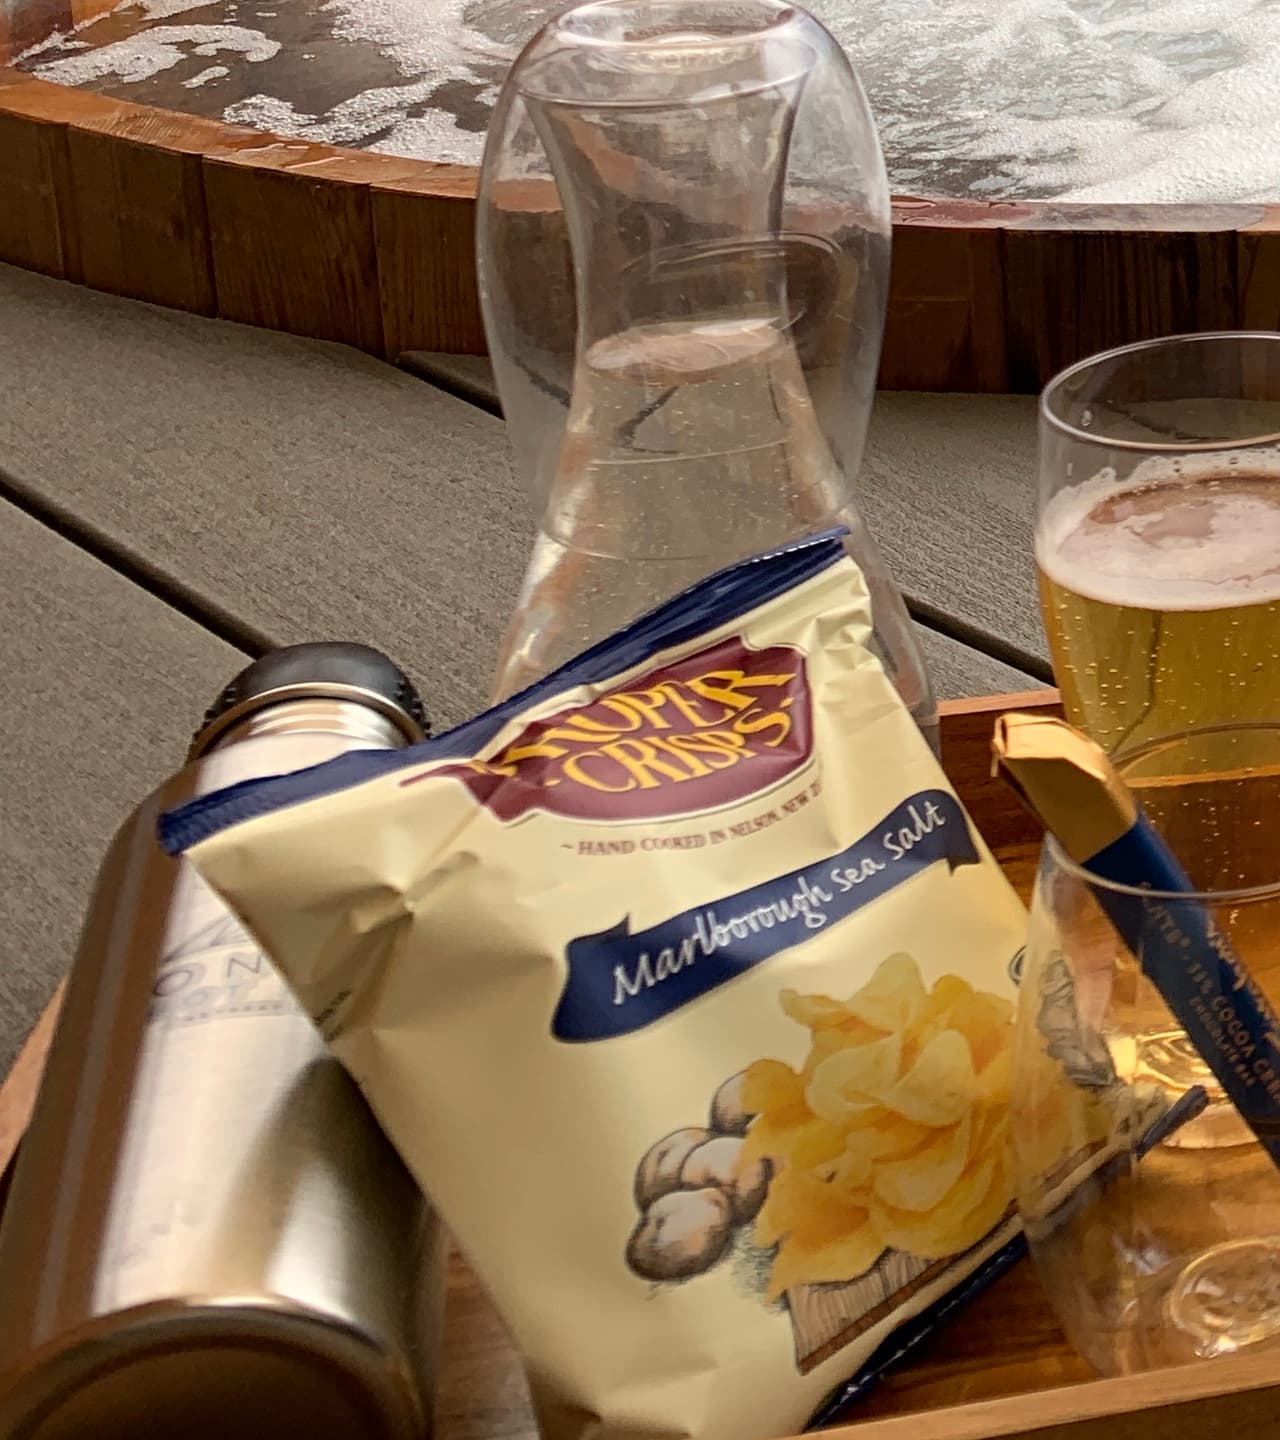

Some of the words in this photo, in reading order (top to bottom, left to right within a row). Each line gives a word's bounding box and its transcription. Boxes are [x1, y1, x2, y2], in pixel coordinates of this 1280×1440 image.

[563, 707, 792, 793] CRISPS
[577, 839, 636, 856] HAND
[639, 831, 707, 853] COOKED
[709, 829, 727, 845] IN
[612, 874, 834, 1006] Marlborough
[1209, 994, 1257, 1057] COCOA
